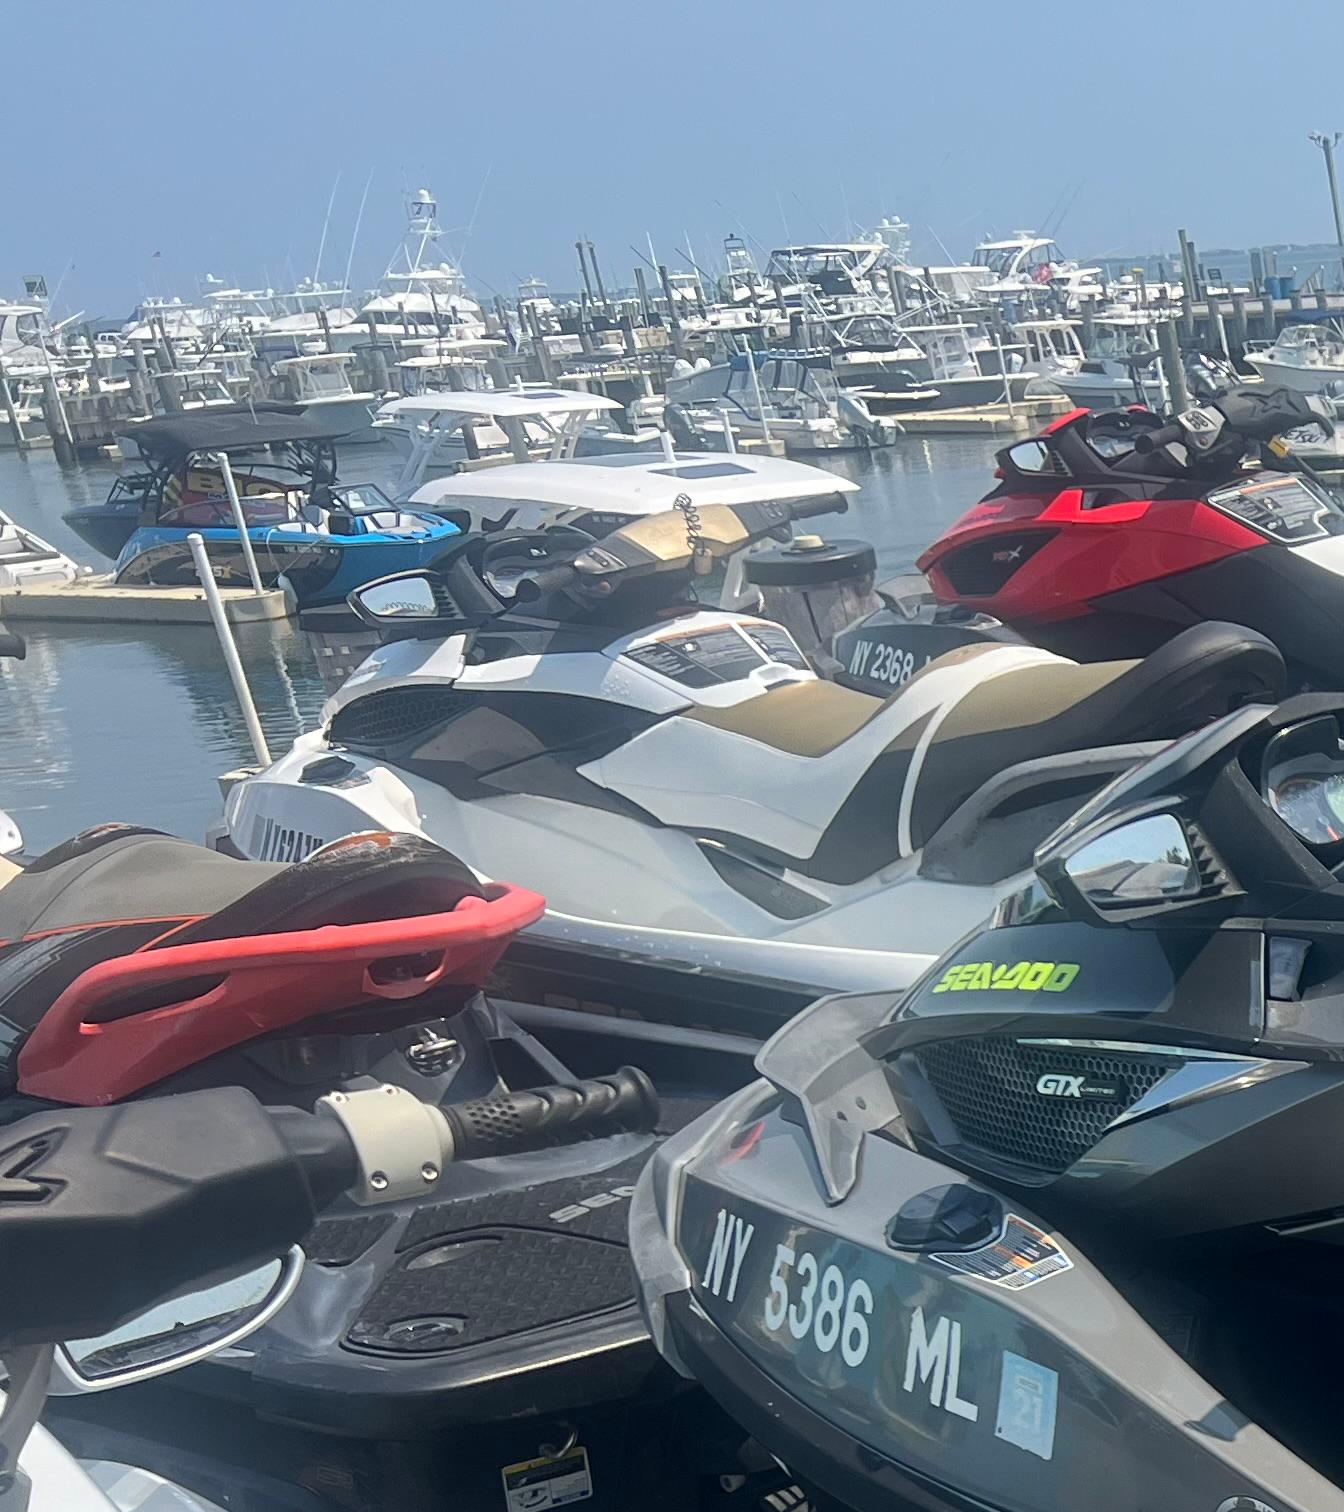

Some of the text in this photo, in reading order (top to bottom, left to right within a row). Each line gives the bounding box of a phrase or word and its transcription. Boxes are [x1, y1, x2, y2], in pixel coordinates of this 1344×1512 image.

[849, 640, 874, 677] NY
[870, 643, 915, 686] 2368
[1036, 1073, 1086, 1098] GTX
[702, 1208, 755, 1302] NY
[764, 1244, 873, 1367] 5386
[902, 1305, 978, 1422] ML
